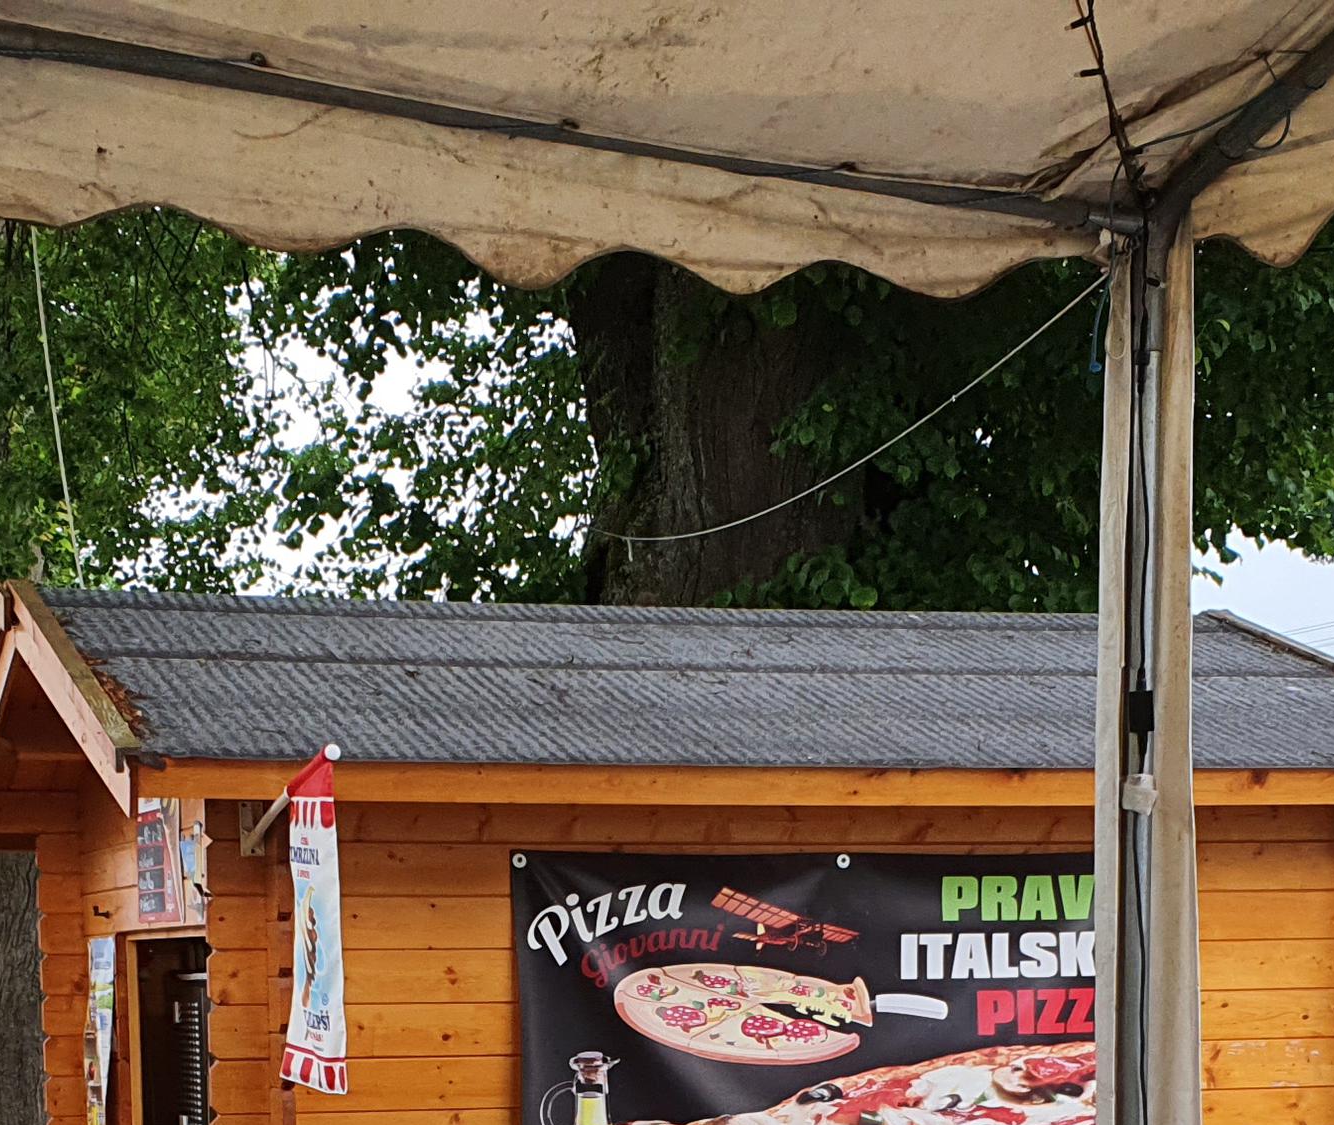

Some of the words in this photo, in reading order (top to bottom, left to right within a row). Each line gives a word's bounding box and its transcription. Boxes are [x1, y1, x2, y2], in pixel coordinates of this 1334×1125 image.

[941, 875, 1095, 922] PRAV
[527, 883, 686, 967] Pizza
[580, 922, 725, 988] Giovanni
[900, 931, 1096, 980] ITALSK
[976, 988, 1095, 1036] PIZZ
